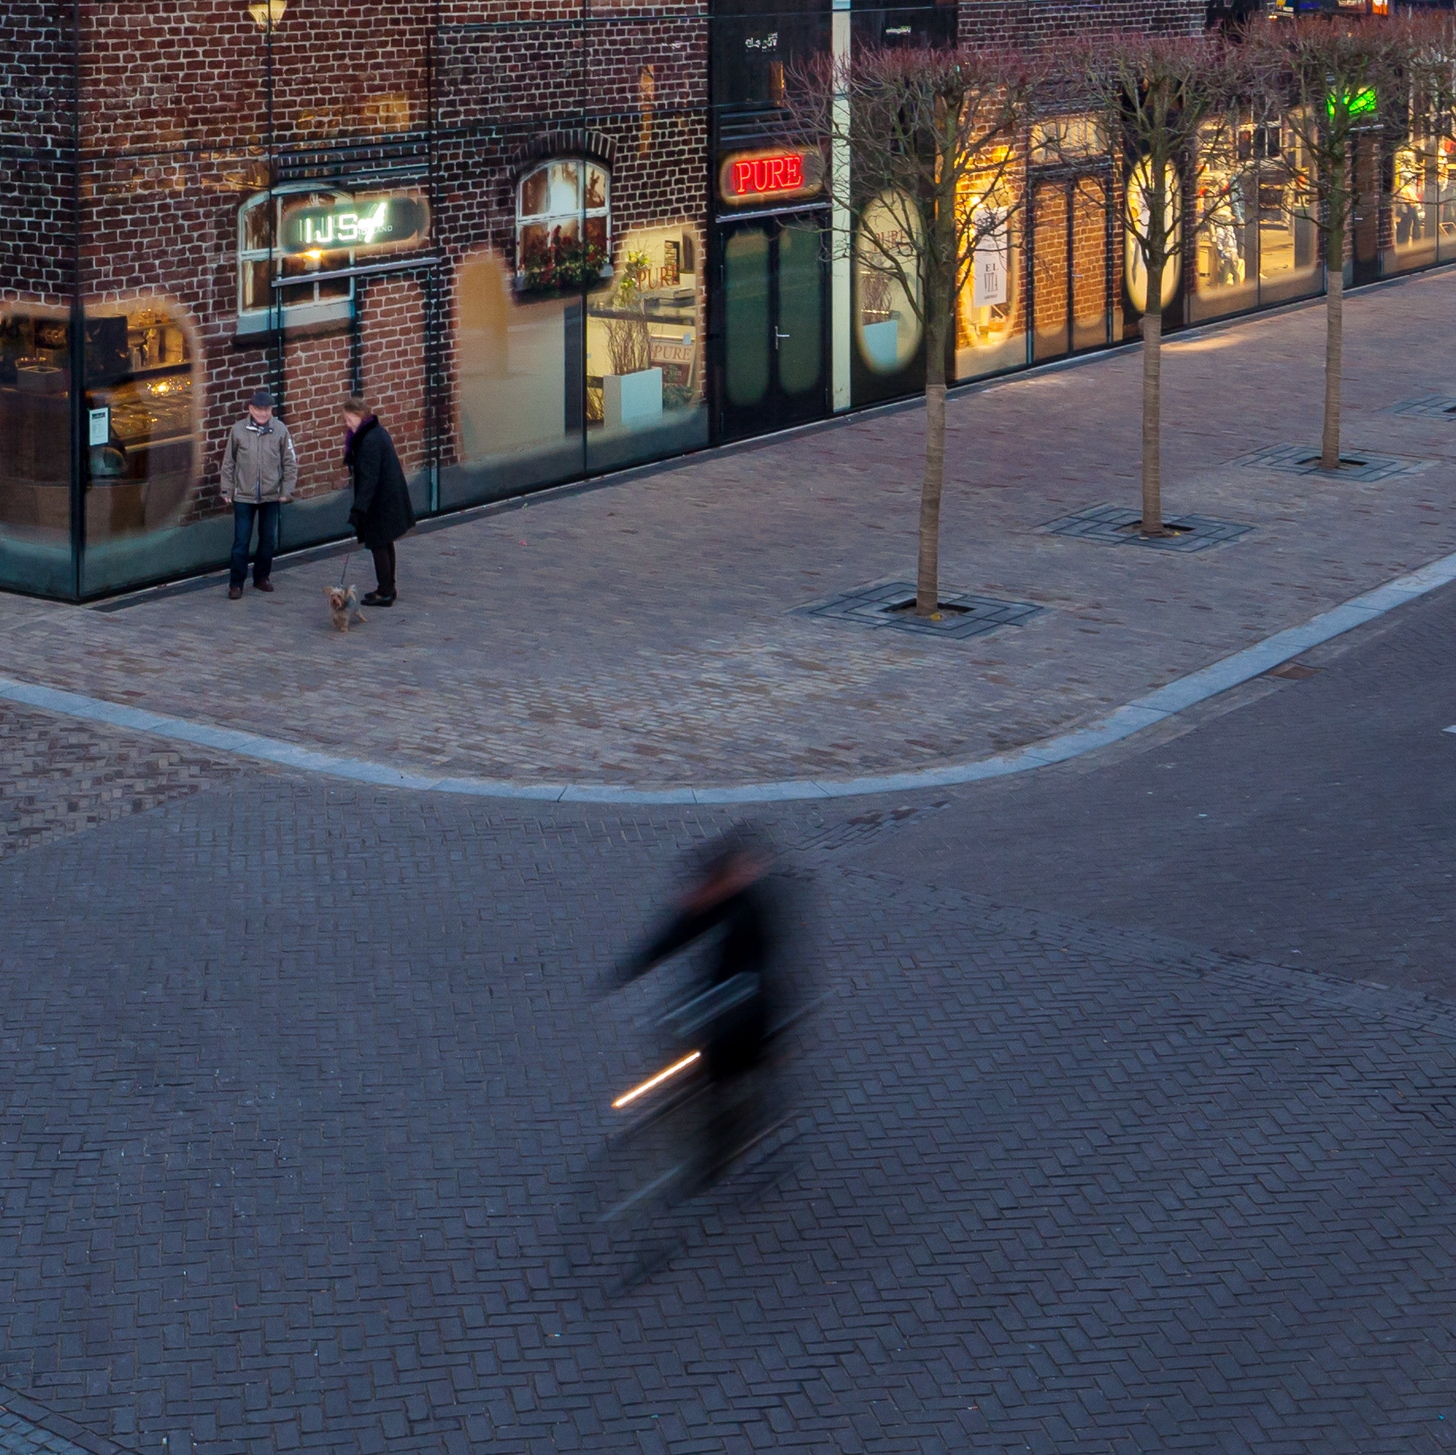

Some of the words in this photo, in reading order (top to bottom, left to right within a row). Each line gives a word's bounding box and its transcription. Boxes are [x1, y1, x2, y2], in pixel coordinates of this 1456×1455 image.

[734, 155, 802, 193] PURE
[637, 265, 680, 291] PURE
[652, 345, 692, 360] PURE
